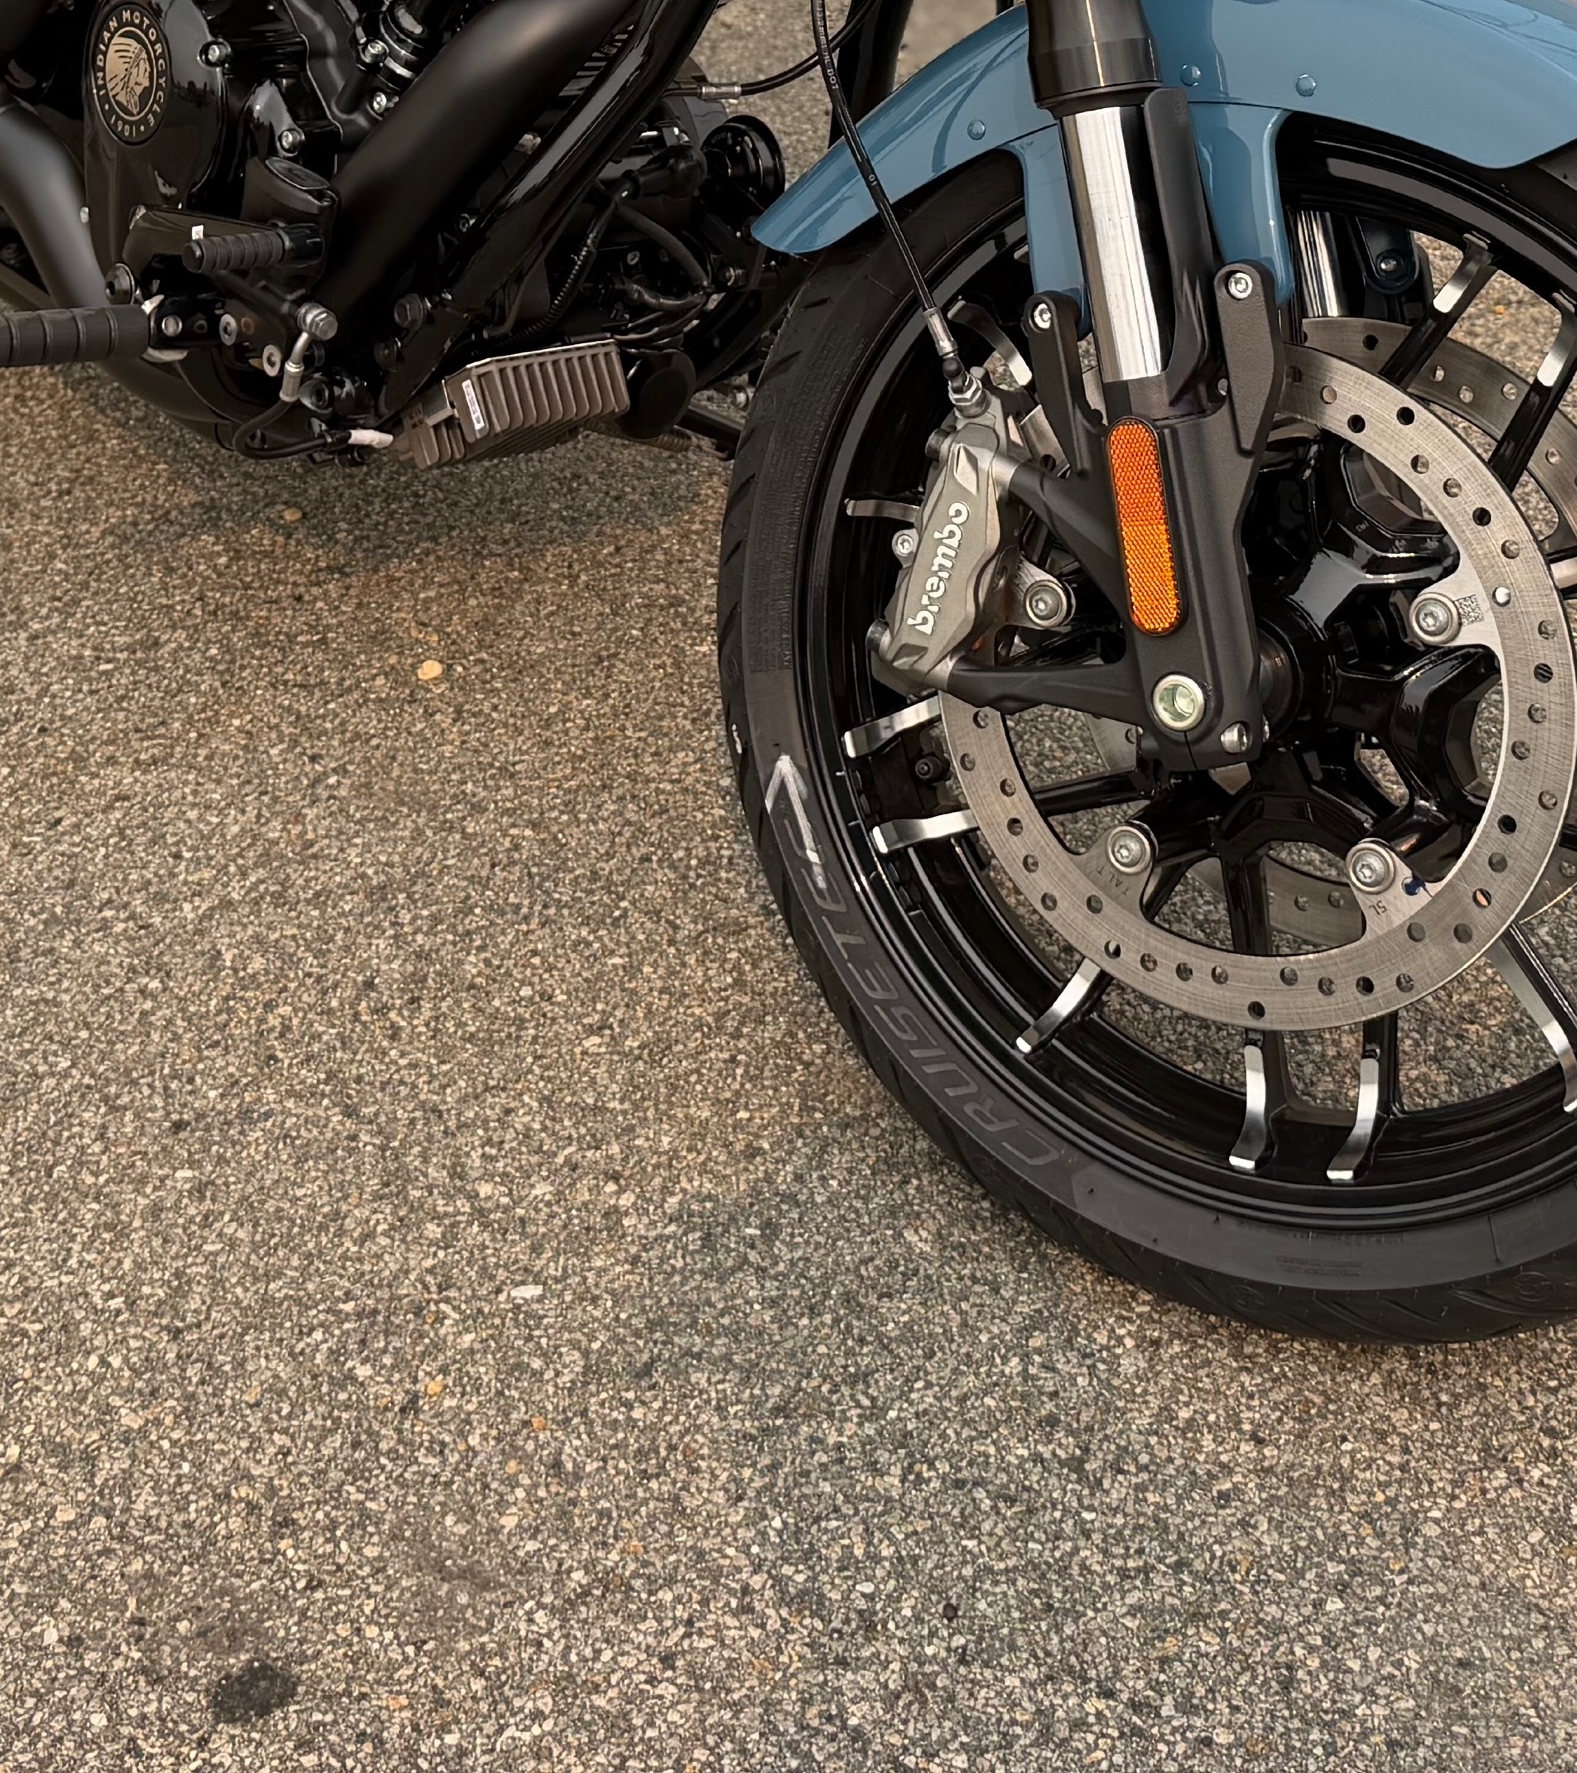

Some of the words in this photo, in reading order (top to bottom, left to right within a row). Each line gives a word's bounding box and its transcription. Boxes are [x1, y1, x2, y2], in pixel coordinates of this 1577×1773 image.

[96, 16, 117, 96] INDIAN
[122, 9, 166, 127] MOTORCYCLE
[111, 114, 137, 138] 1901
[907, 501, 970, 636] brembo
